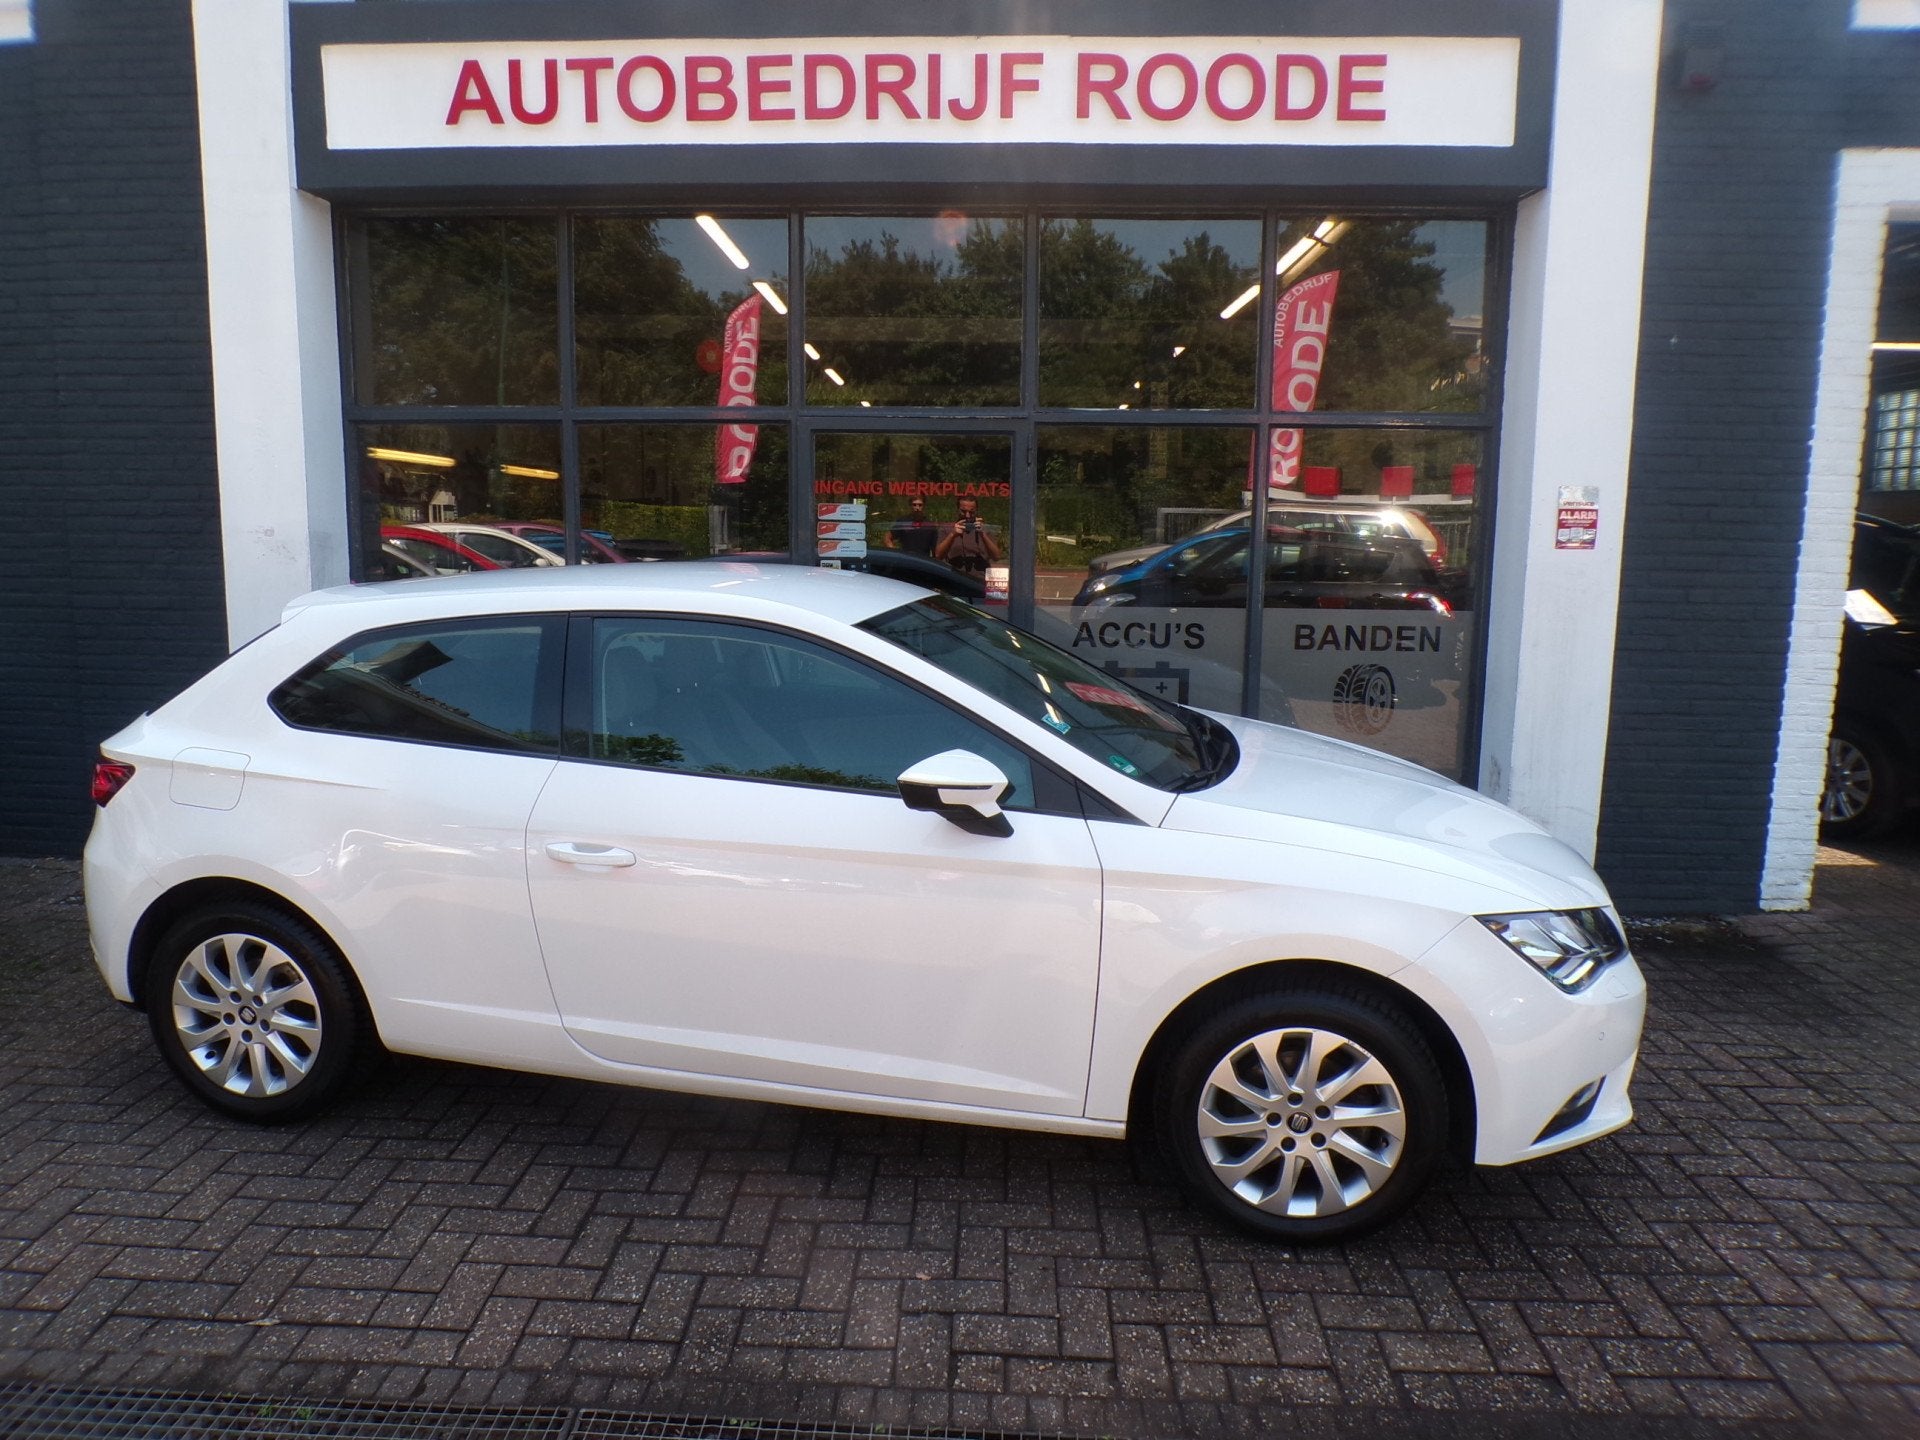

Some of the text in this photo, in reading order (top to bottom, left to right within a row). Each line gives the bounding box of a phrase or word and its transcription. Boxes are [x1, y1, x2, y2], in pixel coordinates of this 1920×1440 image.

[446, 53, 1387, 125] AUTOBEDRIJF ROODE
[1273, 273, 1333, 348] AUTOBEDRIJF
[1271, 299, 1334, 485] ROODE
[889, 481, 1010, 497] WERKPLAATS
[1559, 510, 1597, 520] ALARM
[1072, 621, 1206, 650] ACCU'S
[1294, 623, 1442, 653] BANDEN
